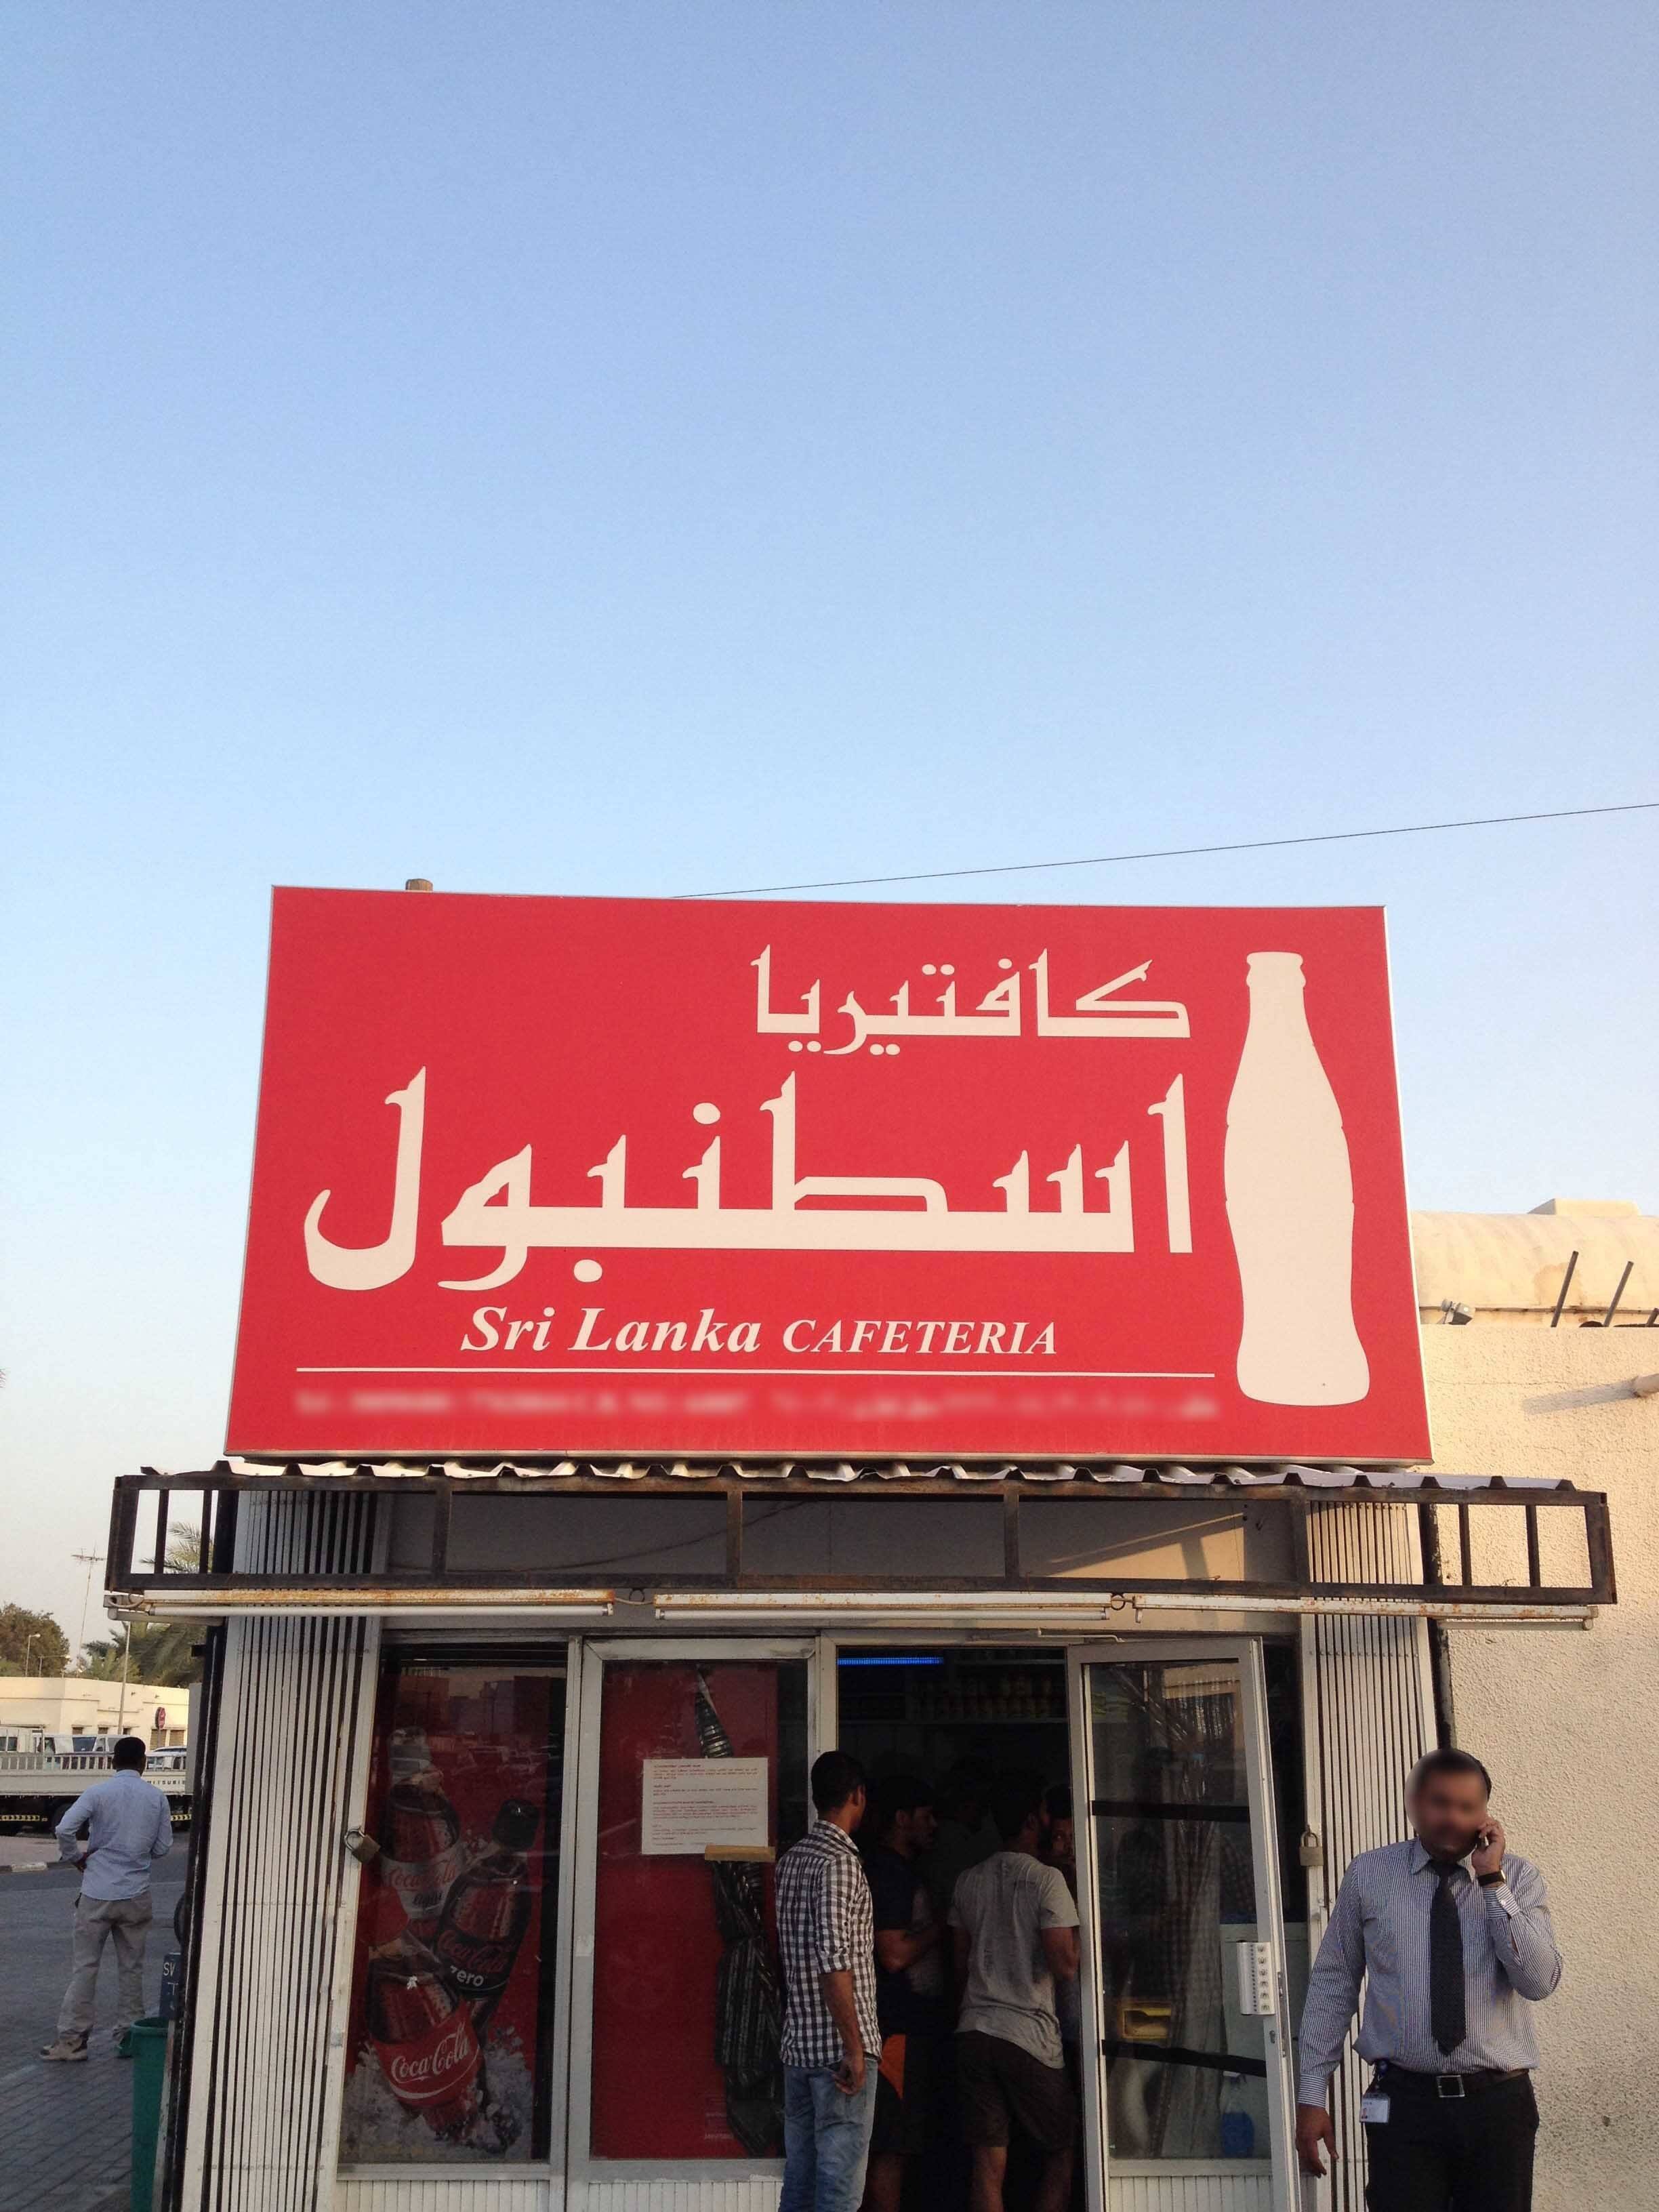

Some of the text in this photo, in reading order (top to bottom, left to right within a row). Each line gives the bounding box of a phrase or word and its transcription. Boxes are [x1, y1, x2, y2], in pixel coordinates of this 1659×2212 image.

[751, 945, 1191, 1055] كافتيريا
[304, 1067, 1193, 1292] اسطنبول
[461, 1307, 1056, 1353] Sri Lanka CAFETERIA
